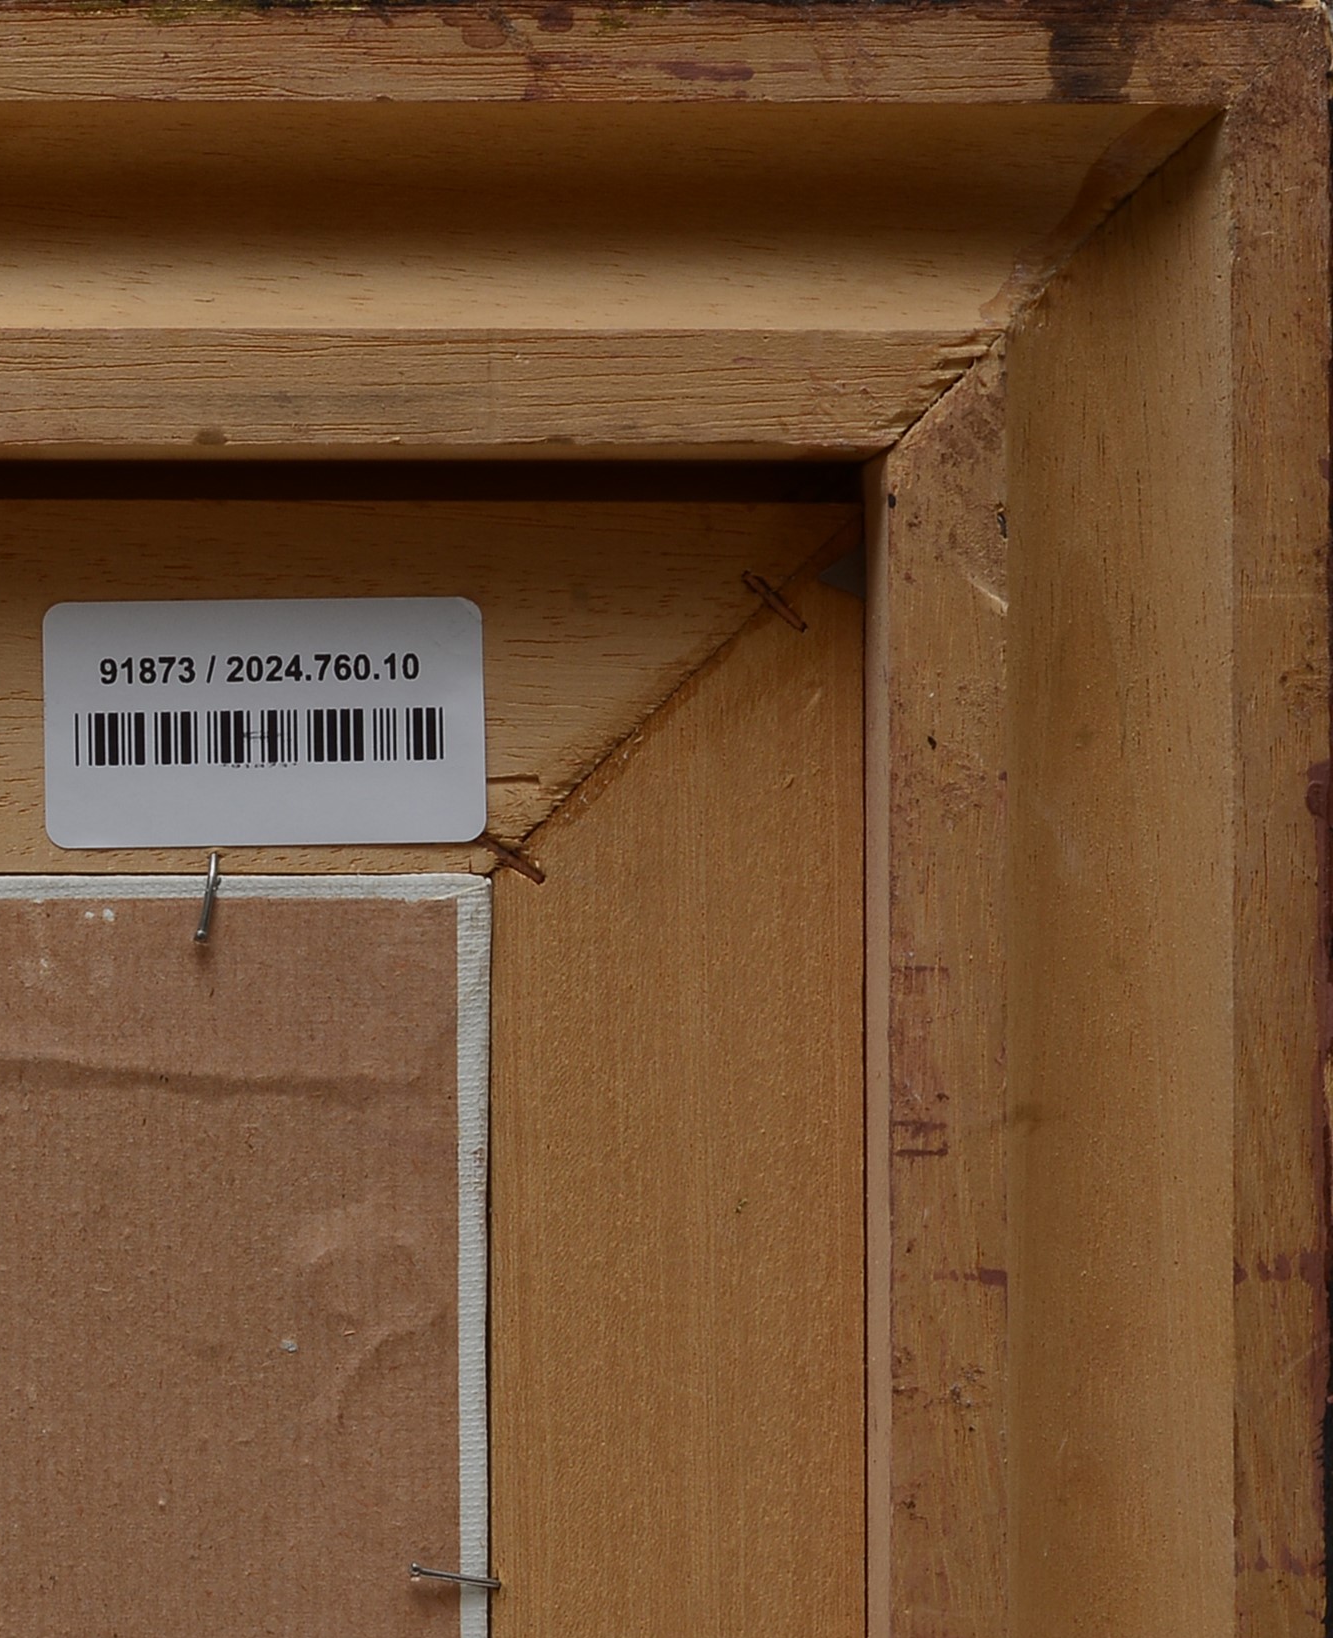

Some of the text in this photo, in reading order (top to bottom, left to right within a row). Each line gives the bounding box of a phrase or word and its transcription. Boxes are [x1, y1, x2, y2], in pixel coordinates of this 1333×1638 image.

[99, 652, 420, 685] 91873 / 2024.760.10
